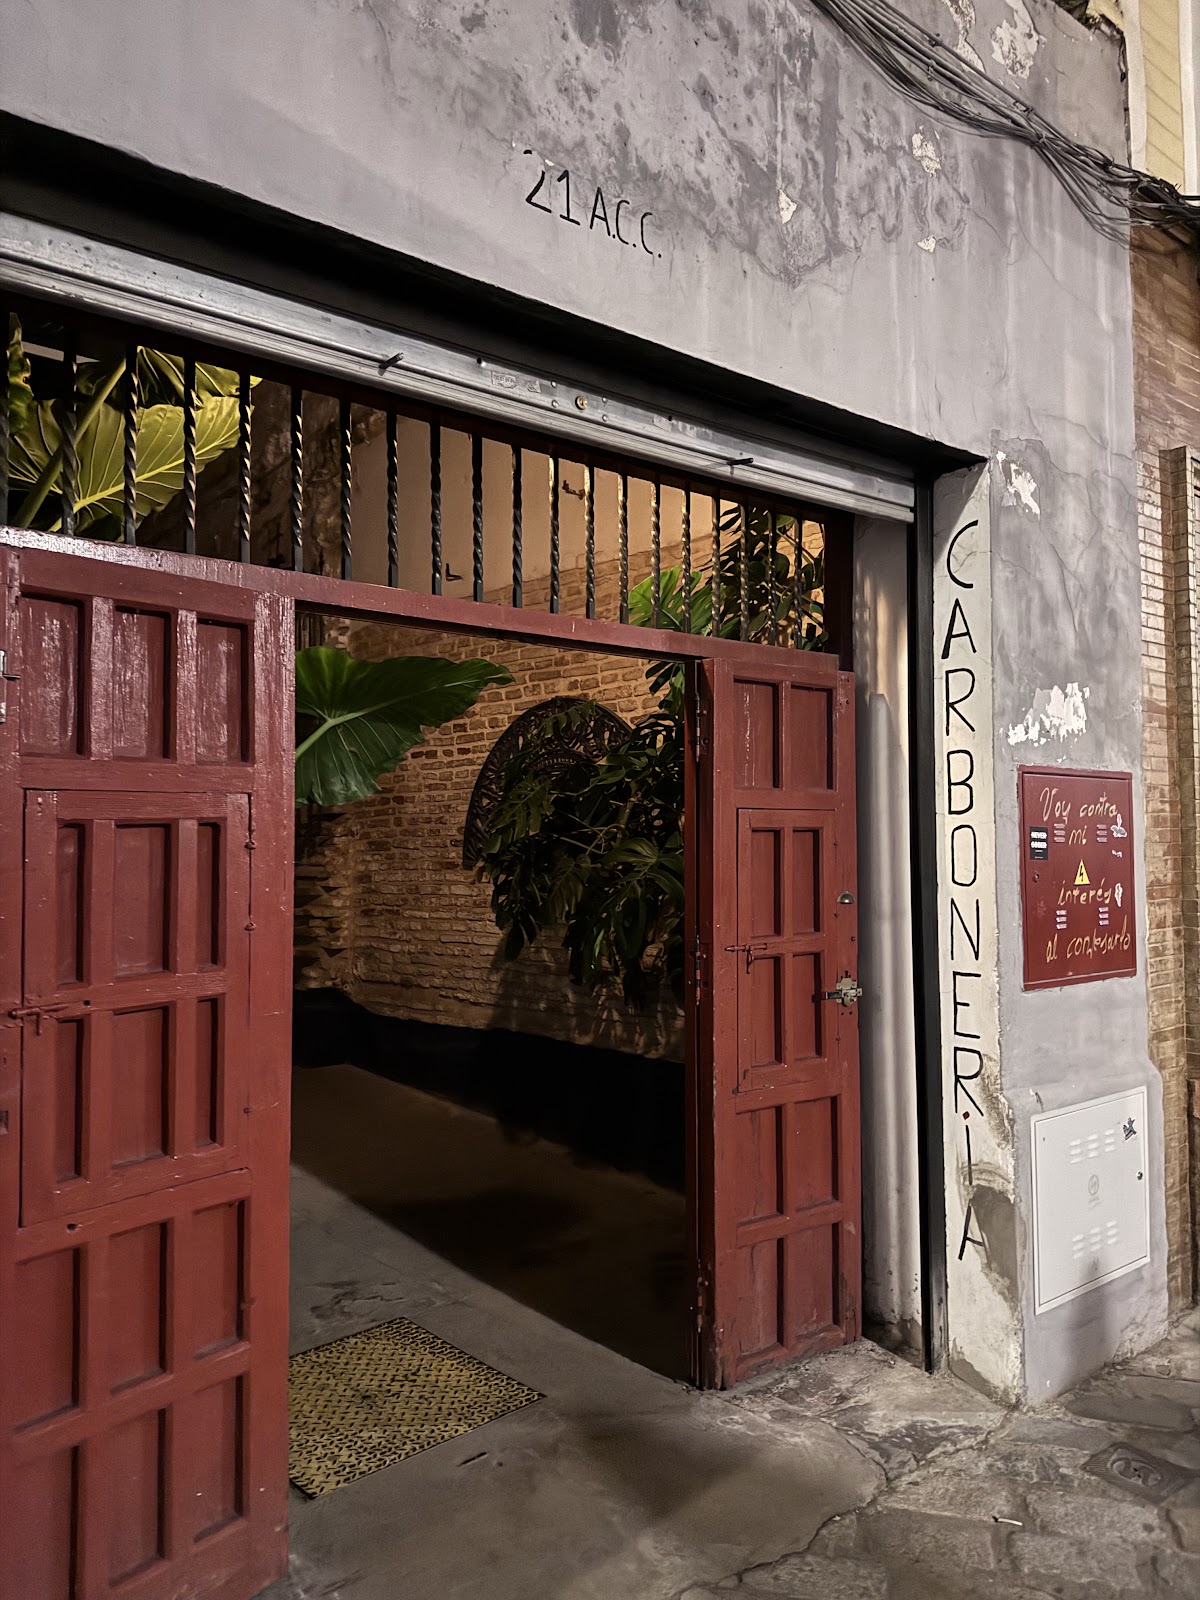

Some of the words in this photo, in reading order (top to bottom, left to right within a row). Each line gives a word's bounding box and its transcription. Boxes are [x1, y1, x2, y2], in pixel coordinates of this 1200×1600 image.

[1039, 787, 1071, 825] Voy
[1079, 792, 1118, 817] contra
[1069, 825, 1087, 845] mi
[1058, 877, 1112, 906] interés
[1046, 933, 1058, 963] al
